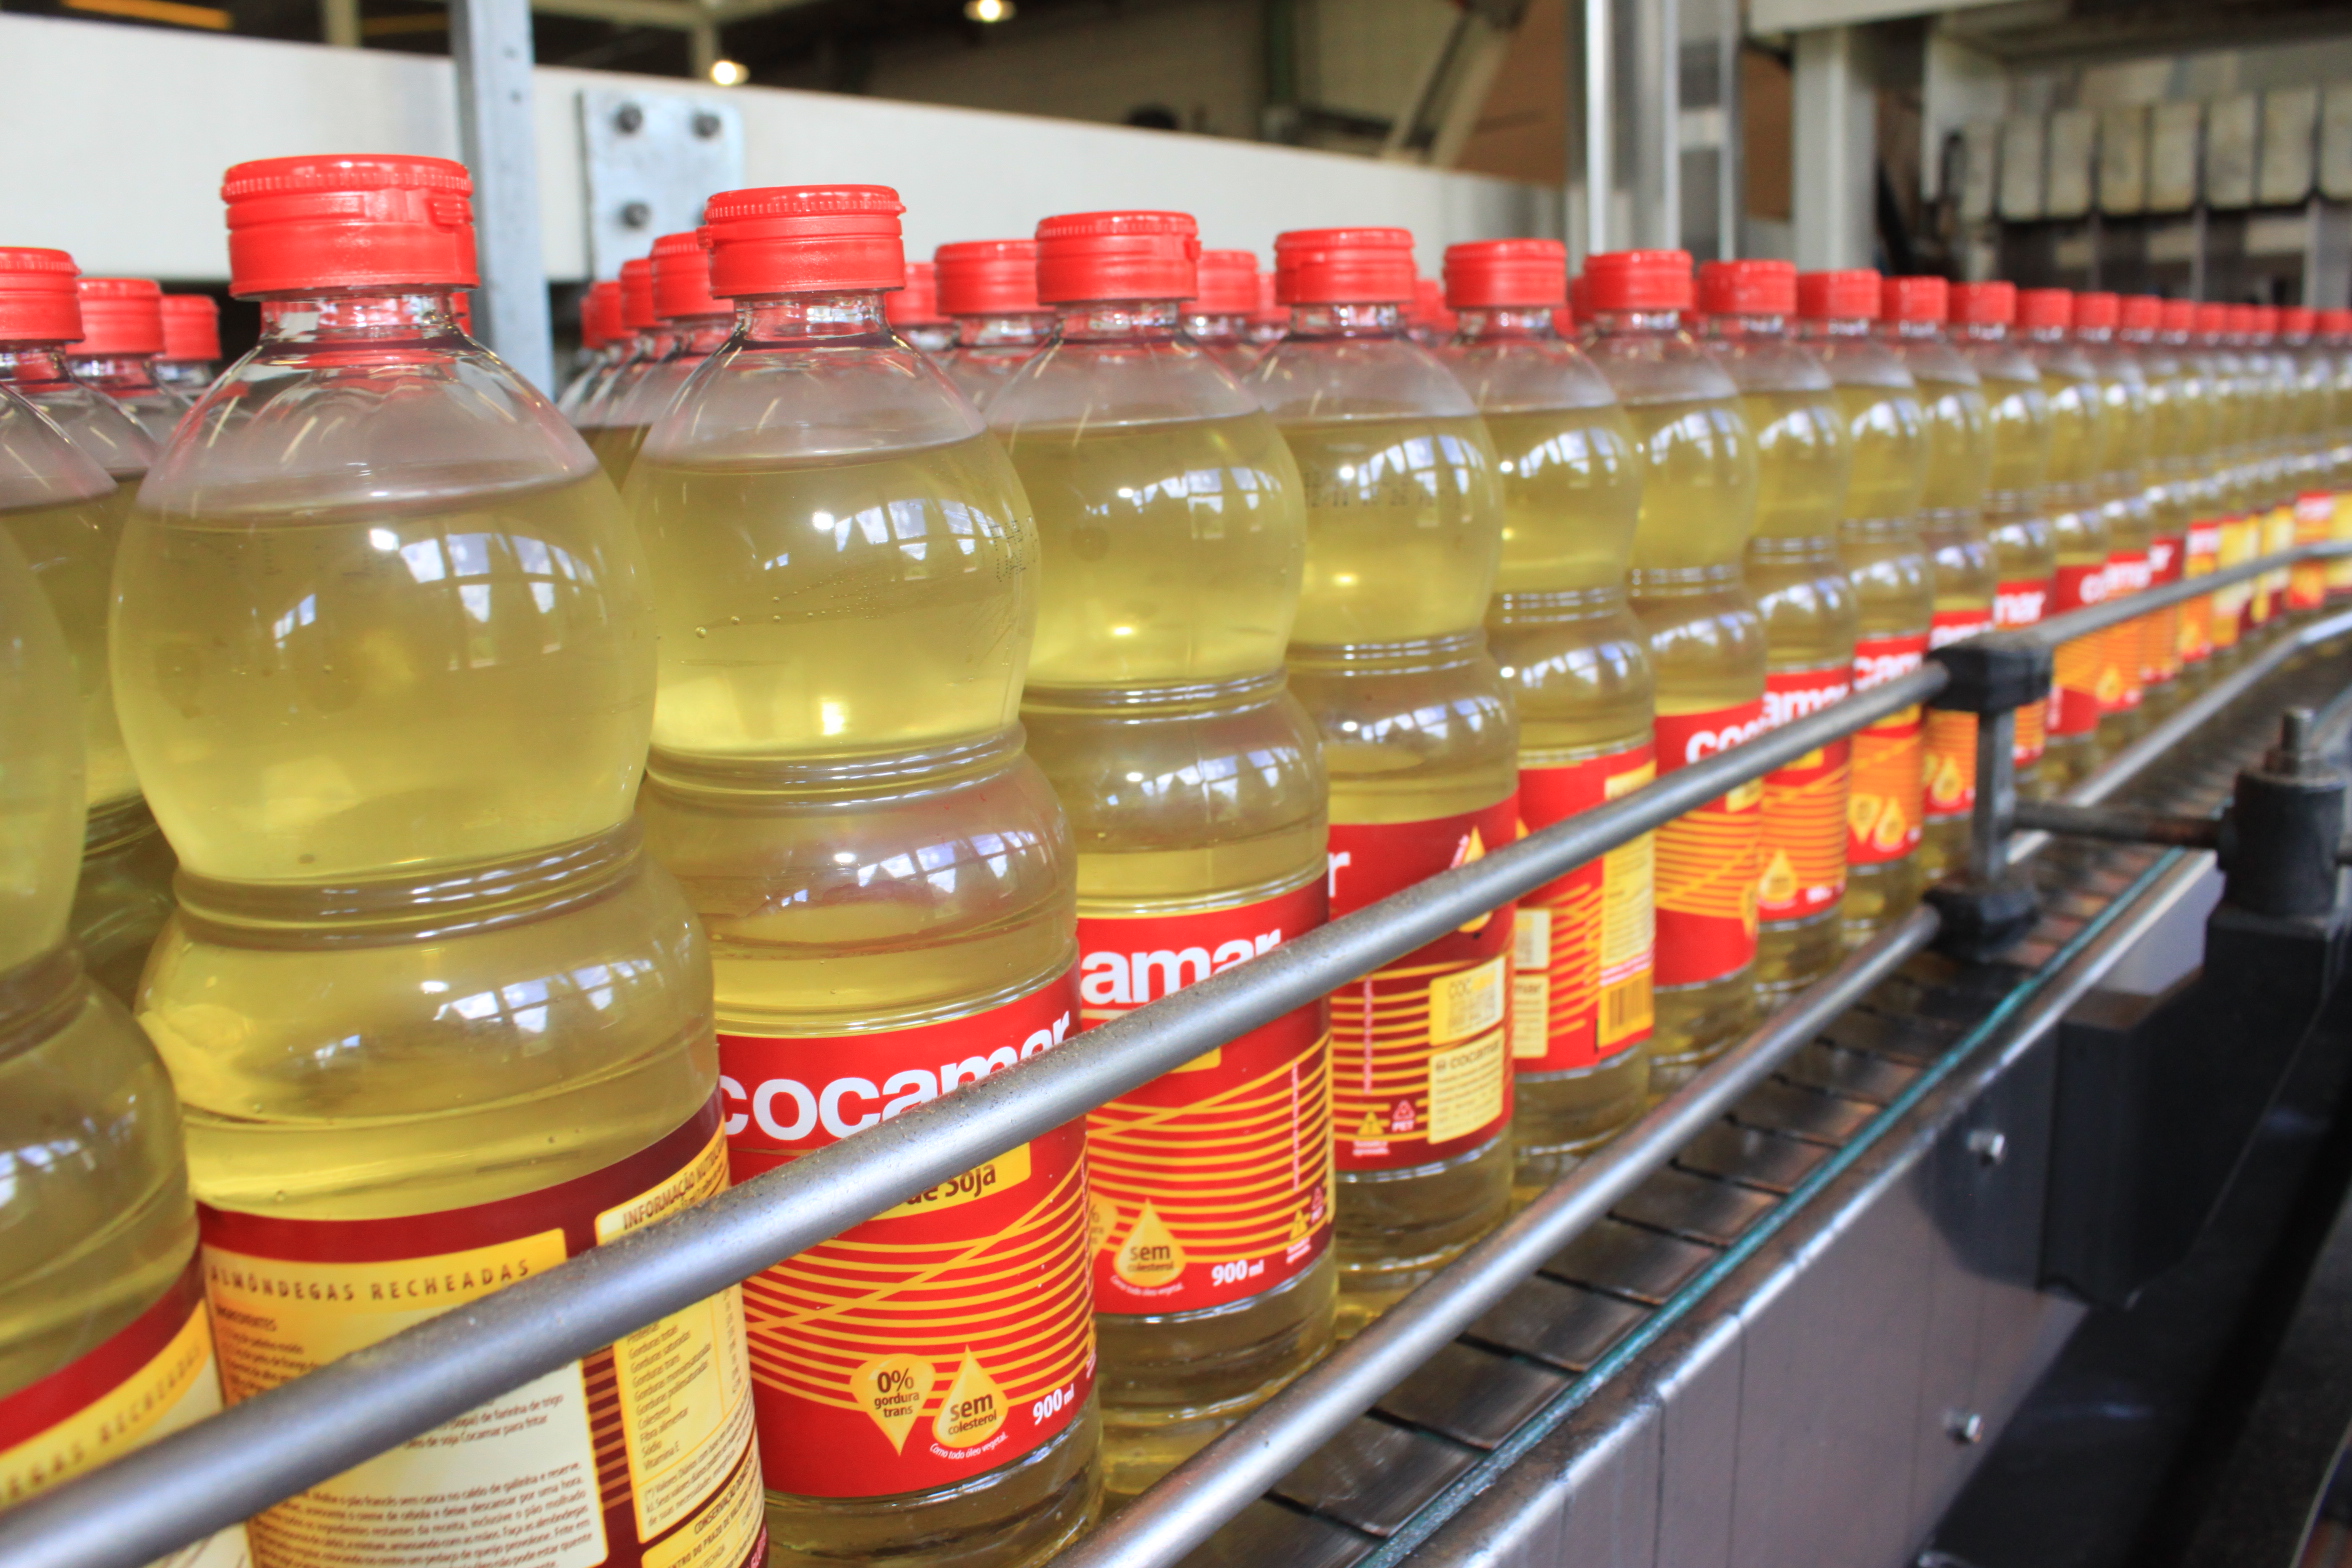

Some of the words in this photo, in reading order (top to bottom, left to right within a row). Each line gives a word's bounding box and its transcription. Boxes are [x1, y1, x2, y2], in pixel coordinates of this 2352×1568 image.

[1130, 1245, 1170, 1261] sem
[210, 1265, 355, 1301] ALMÔNDEGAS
[370, 1259, 529, 1300] RECHEADAS
[1212, 1260, 1248, 1286] 900
[877, 1368, 914, 1393] 0%
[874, 1392, 919, 1409] gordura
[883, 1404, 913, 1418] trans
[950, 1394, 993, 1421] sem
[1033, 1389, 1062, 1425] 900
[1064, 1383, 1075, 1404] ml
[948, 1410, 997, 1435] colesterol
[930, 1443, 948, 1459] Como
